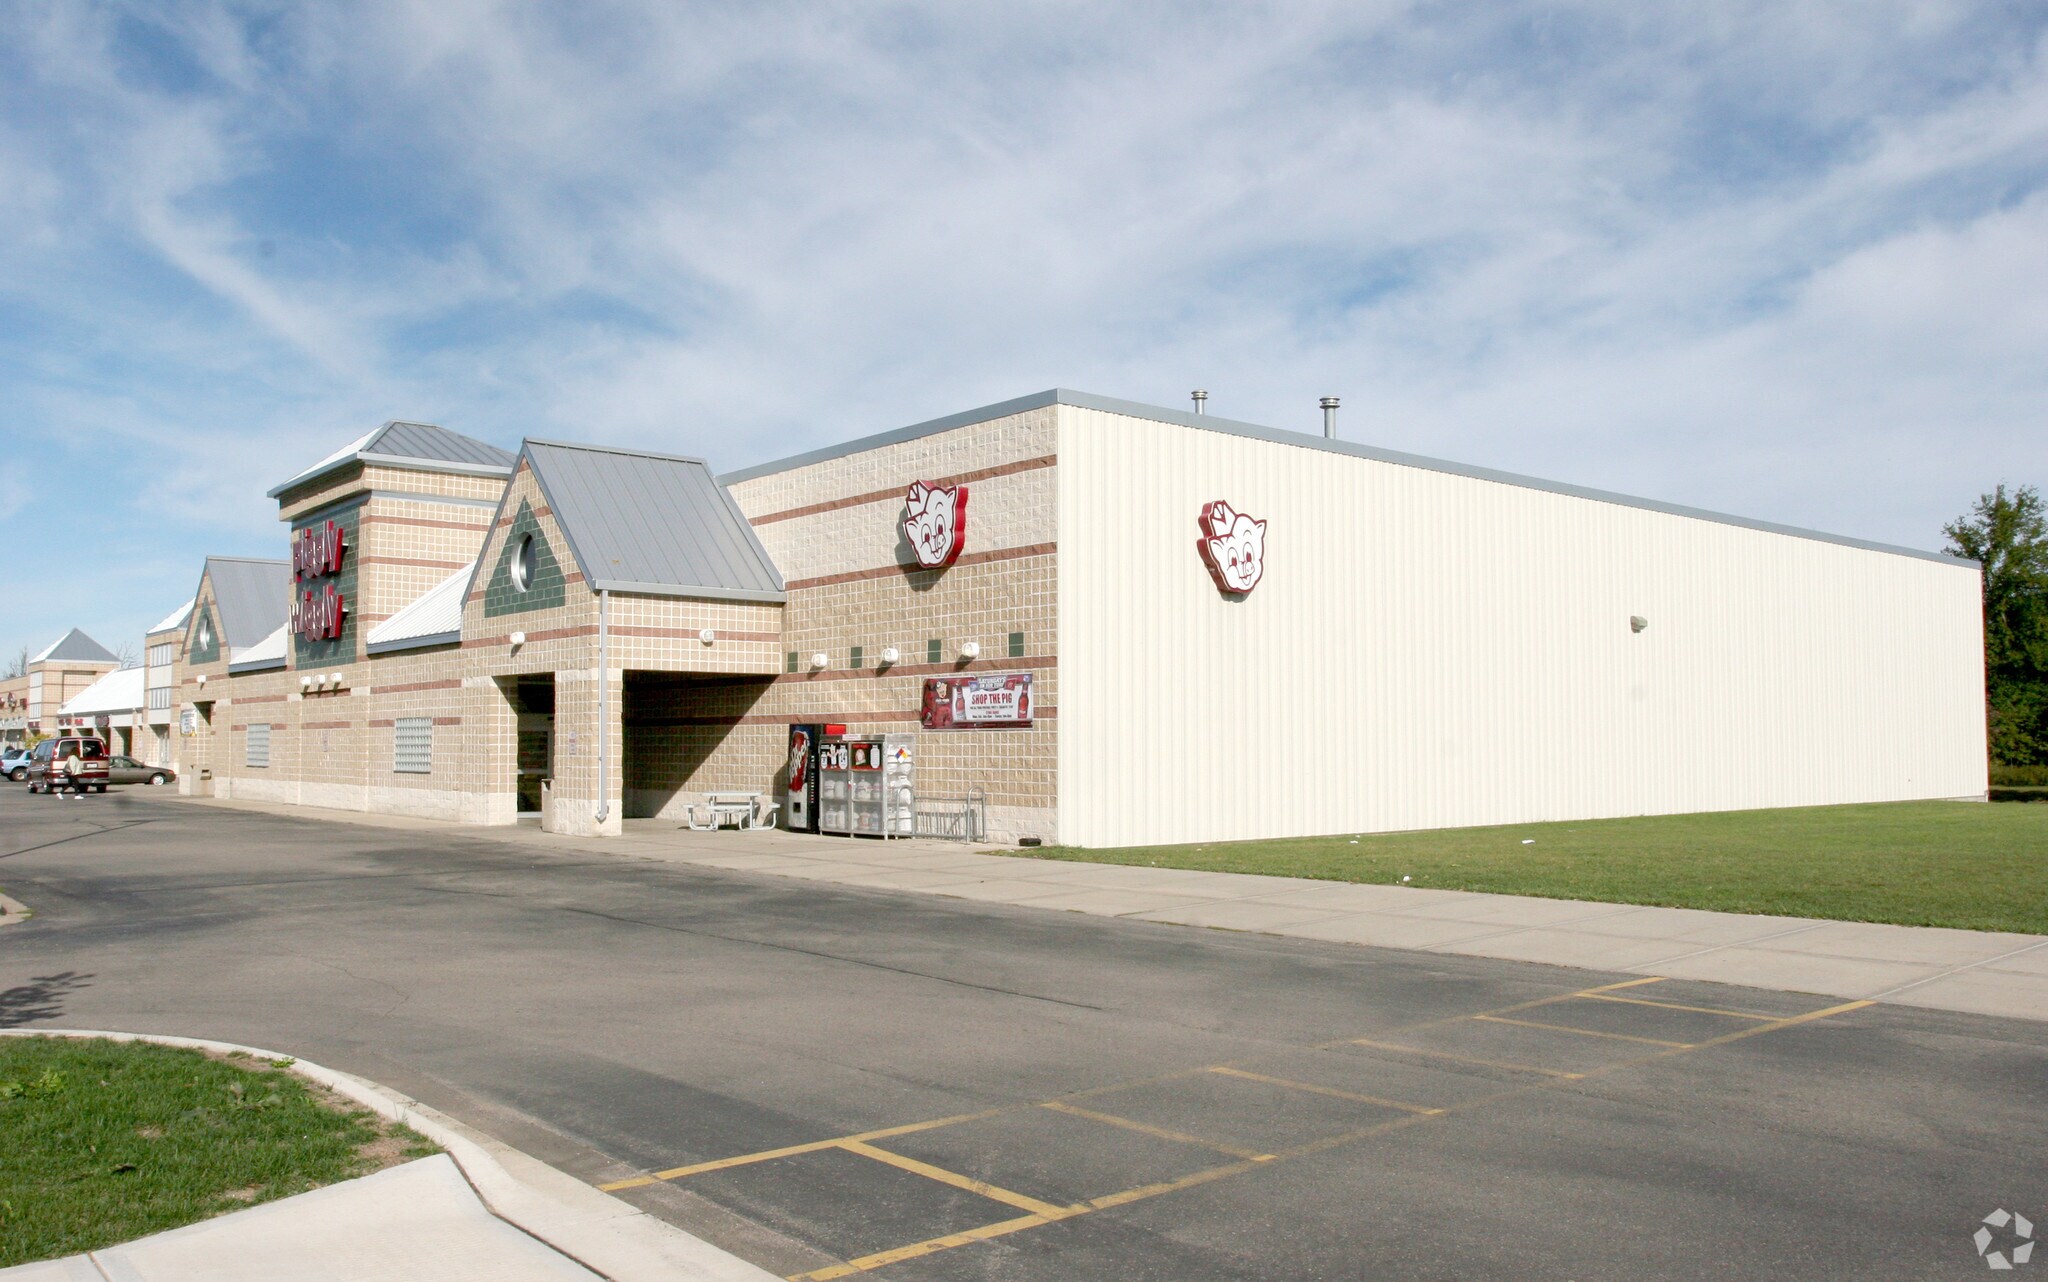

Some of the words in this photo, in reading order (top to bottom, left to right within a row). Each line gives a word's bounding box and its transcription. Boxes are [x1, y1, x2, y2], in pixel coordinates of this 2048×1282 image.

[971, 694, 988, 705] SHOP
[989, 693, 1001, 704] THE
[1002, 692, 1013, 704] PIG
